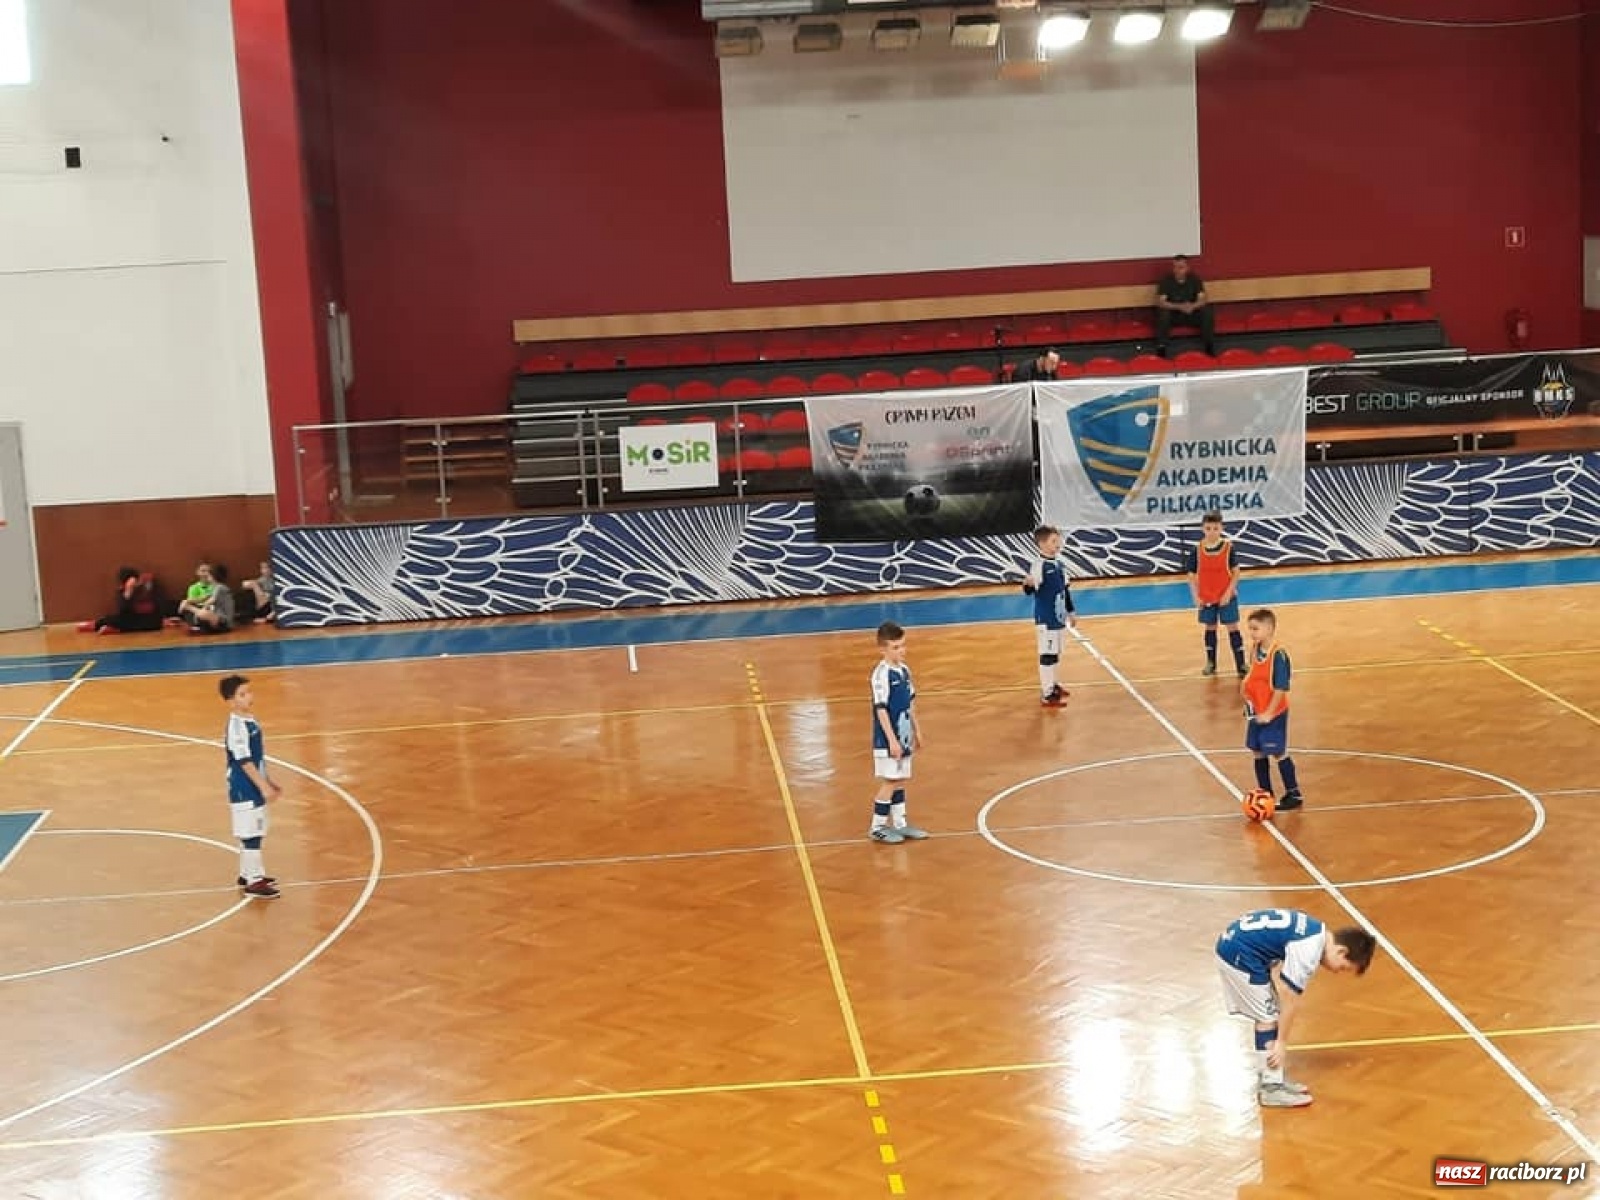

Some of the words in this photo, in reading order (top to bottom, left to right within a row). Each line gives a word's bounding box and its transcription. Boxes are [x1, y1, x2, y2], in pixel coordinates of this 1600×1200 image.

[1356, 391, 1420, 411] GROUP
[1169, 437, 1276, 460] RYBNICKA
[1157, 464, 1269, 487] AKADEMIA
